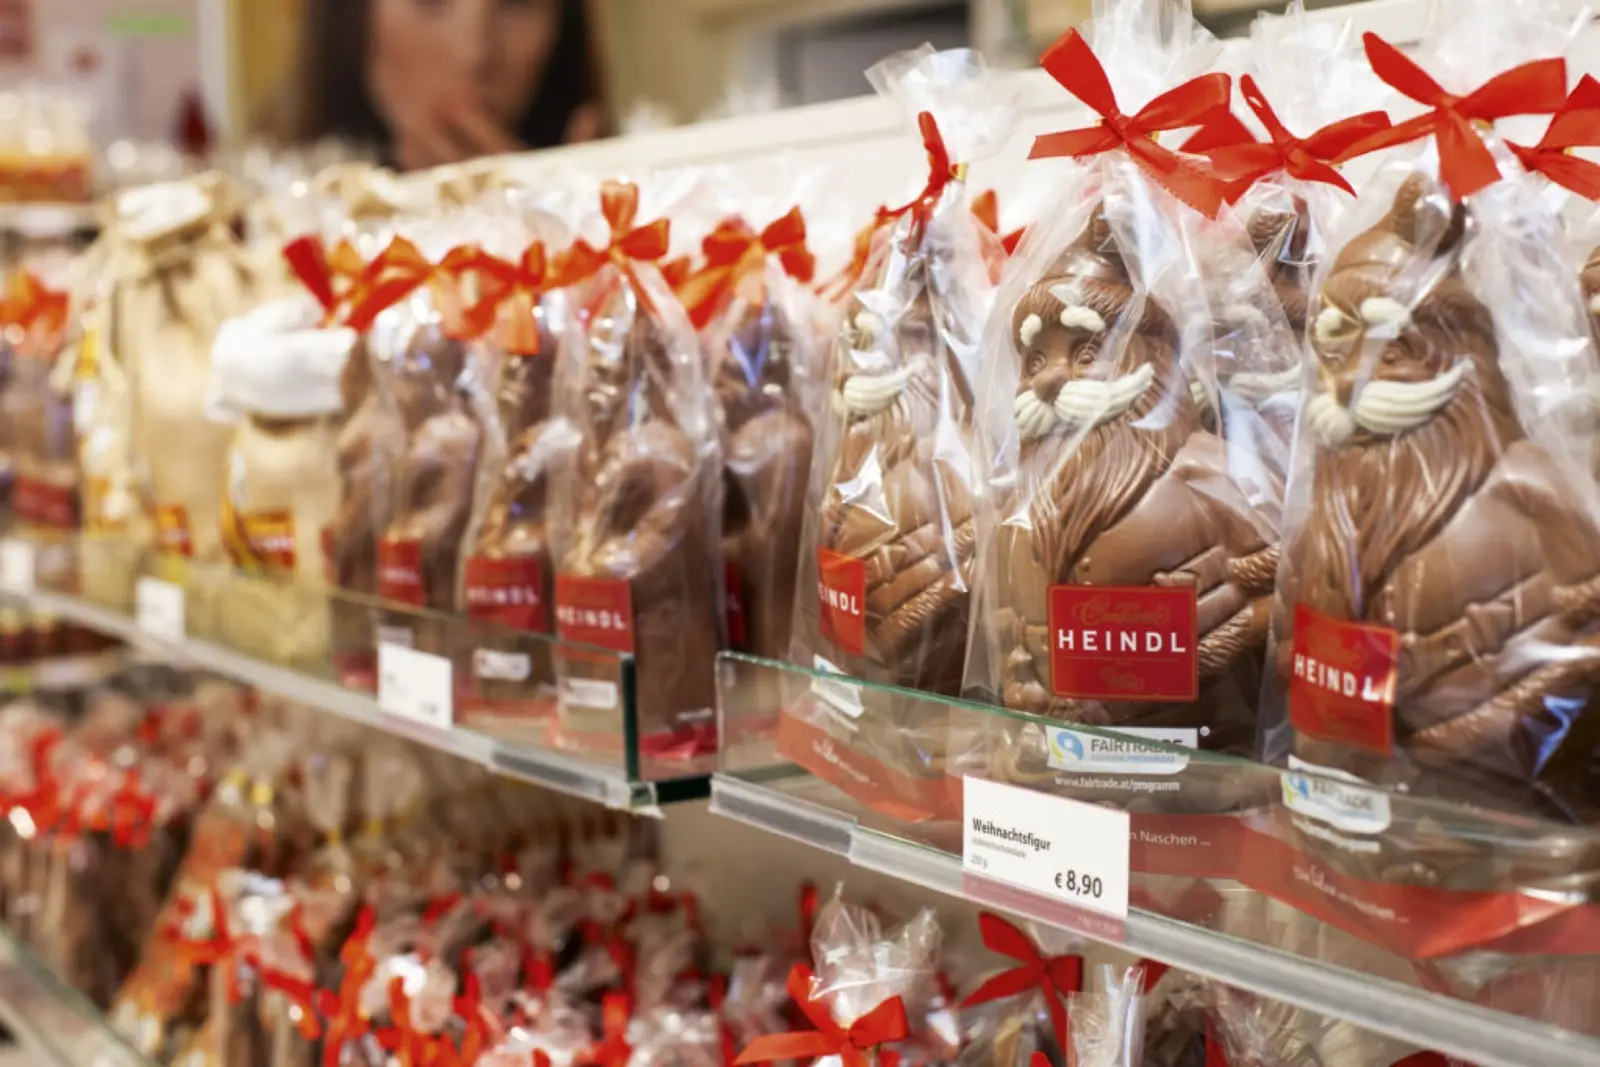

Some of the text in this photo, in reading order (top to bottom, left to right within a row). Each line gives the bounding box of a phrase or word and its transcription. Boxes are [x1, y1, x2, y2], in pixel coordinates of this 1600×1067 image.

[1057, 628, 1187, 653] HEINDL
[1294, 653, 1381, 702] HEINDL
[972, 816, 1051, 852] Weihnachtsfigur
[1139, 829, 1197, 846] Naschen
[1066, 869, 1103, 898] 8,90
